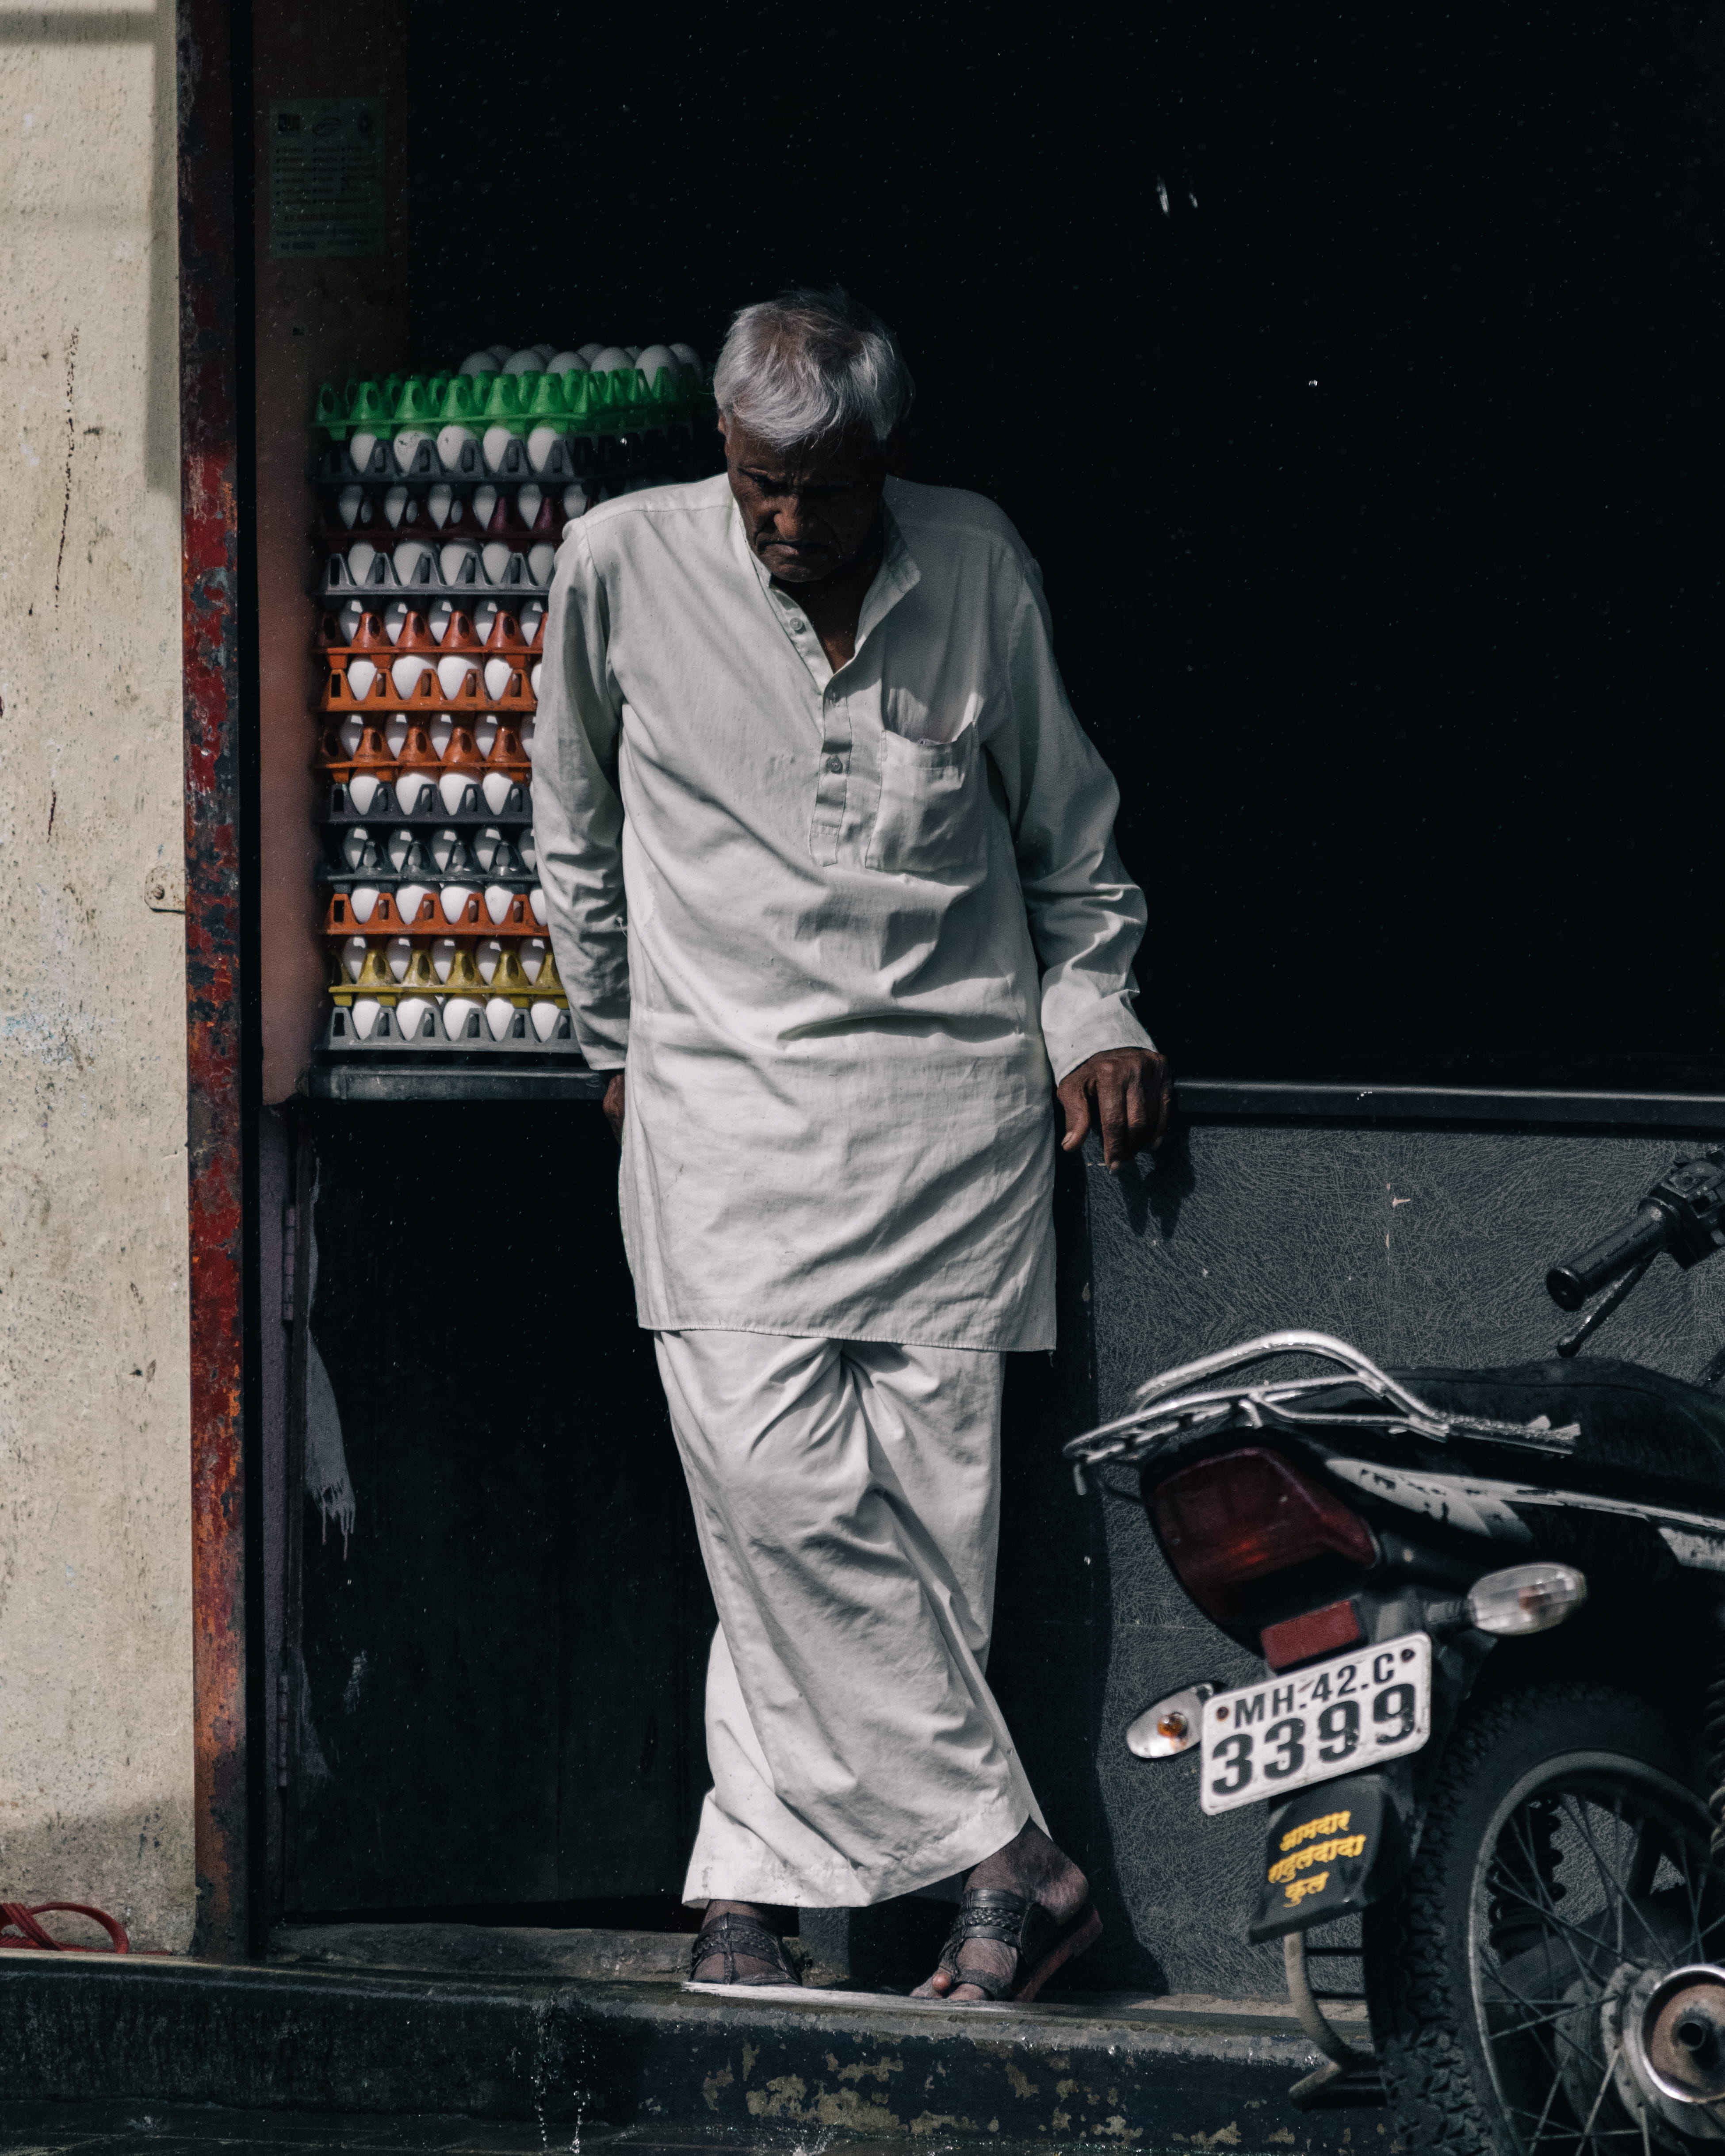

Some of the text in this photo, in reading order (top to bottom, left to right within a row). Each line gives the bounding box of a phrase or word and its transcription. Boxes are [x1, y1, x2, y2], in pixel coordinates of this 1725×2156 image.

[1212, 1683, 1415, 1796] 3399
[1279, 1810, 1351, 1851] आमदार
[1284, 1871, 1330, 1908] कुल
